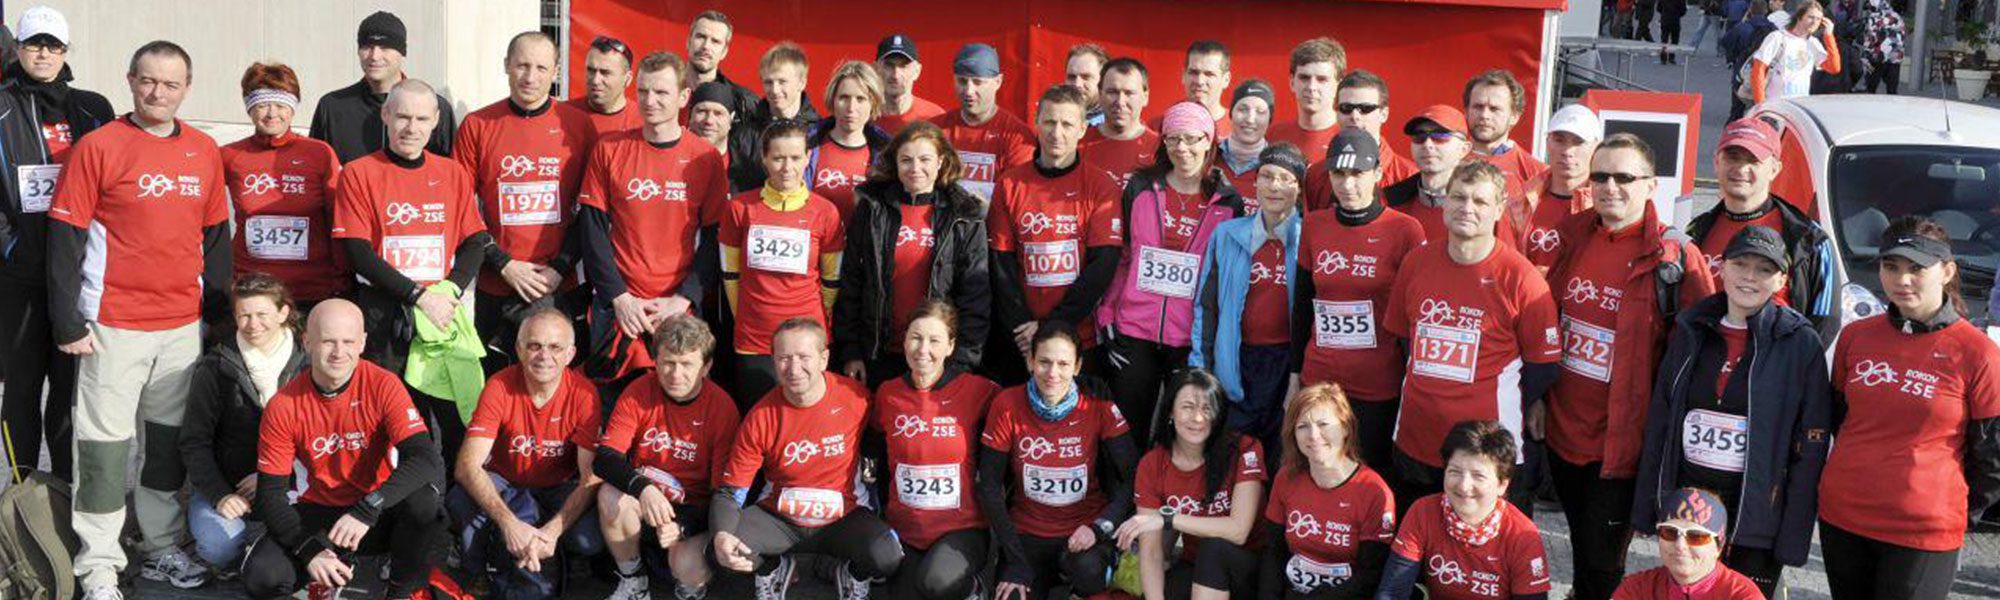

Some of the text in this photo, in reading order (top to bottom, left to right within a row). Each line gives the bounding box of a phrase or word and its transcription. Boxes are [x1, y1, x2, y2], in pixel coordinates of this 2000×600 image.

[538, 166, 560, 177] ZSE
[179, 184, 201, 196] ZSE
[282, 183, 305, 194] ZSE
[664, 190, 687, 201] ZSE
[506, 194, 555, 211] 1979
[423, 212, 446, 222] ZSE
[1056, 223, 1077, 234] ZSE
[252, 228, 305, 246] 3457
[753, 238, 804, 259] 3429
[392, 250, 442, 266] 1794
[1028, 252, 1075, 273] 1070
[1143, 260, 1193, 285] 3380
[1352, 266, 1376, 278] ZSE
[1321, 315, 1369, 334] 3355
[1457, 316, 1482, 330] ZSE
[1420, 338, 1469, 364] 1371
[1900, 380, 1936, 400] ZSE
[932, 426, 956, 438] ZSE
[1688, 424, 1747, 453] 3459
[542, 448, 564, 458] ZSE
[673, 448, 697, 461] ZSE
[823, 444, 845, 458] ZSE
[1058, 446, 1083, 458] ZSE
[903, 477, 955, 495] 3243
[1031, 477, 1084, 493] 3210
[787, 500, 840, 519] 1787
[1208, 498, 1232, 515] ZSE
[1324, 531, 1351, 547] ZSE
[1471, 582, 1500, 597] ZSE
